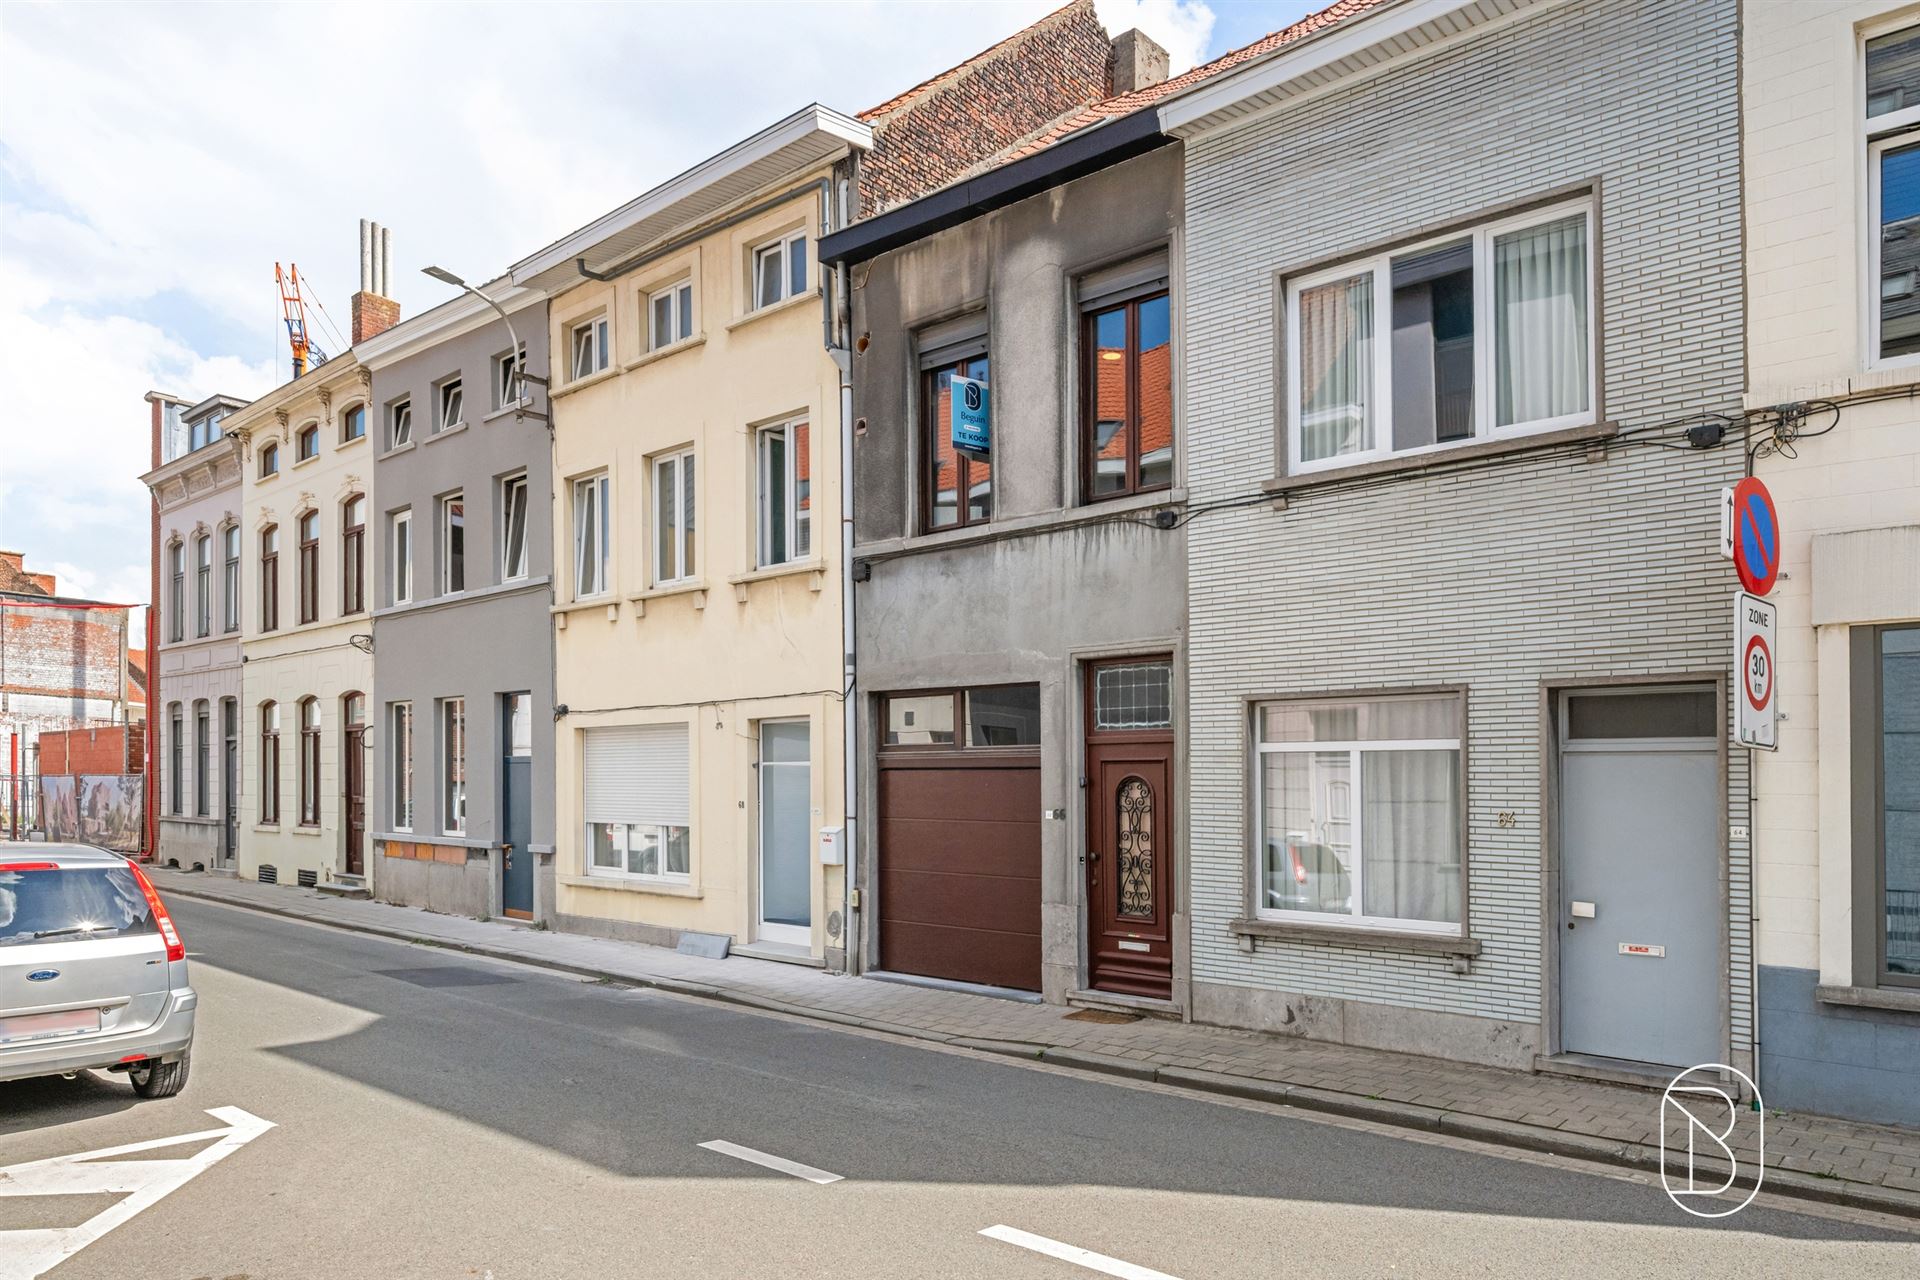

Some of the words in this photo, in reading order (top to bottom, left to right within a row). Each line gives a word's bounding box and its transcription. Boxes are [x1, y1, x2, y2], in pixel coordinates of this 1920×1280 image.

[960, 411, 986, 424] Beguin
[958, 431, 967, 440] TE
[969, 434, 989, 443] KOOP
[1748, 608, 1769, 628] ZONE
[1752, 653, 1765, 678] 30
[1754, 679, 1763, 695] km
[1053, 808, 1066, 820] 66
[1497, 811, 1517, 828] 64
